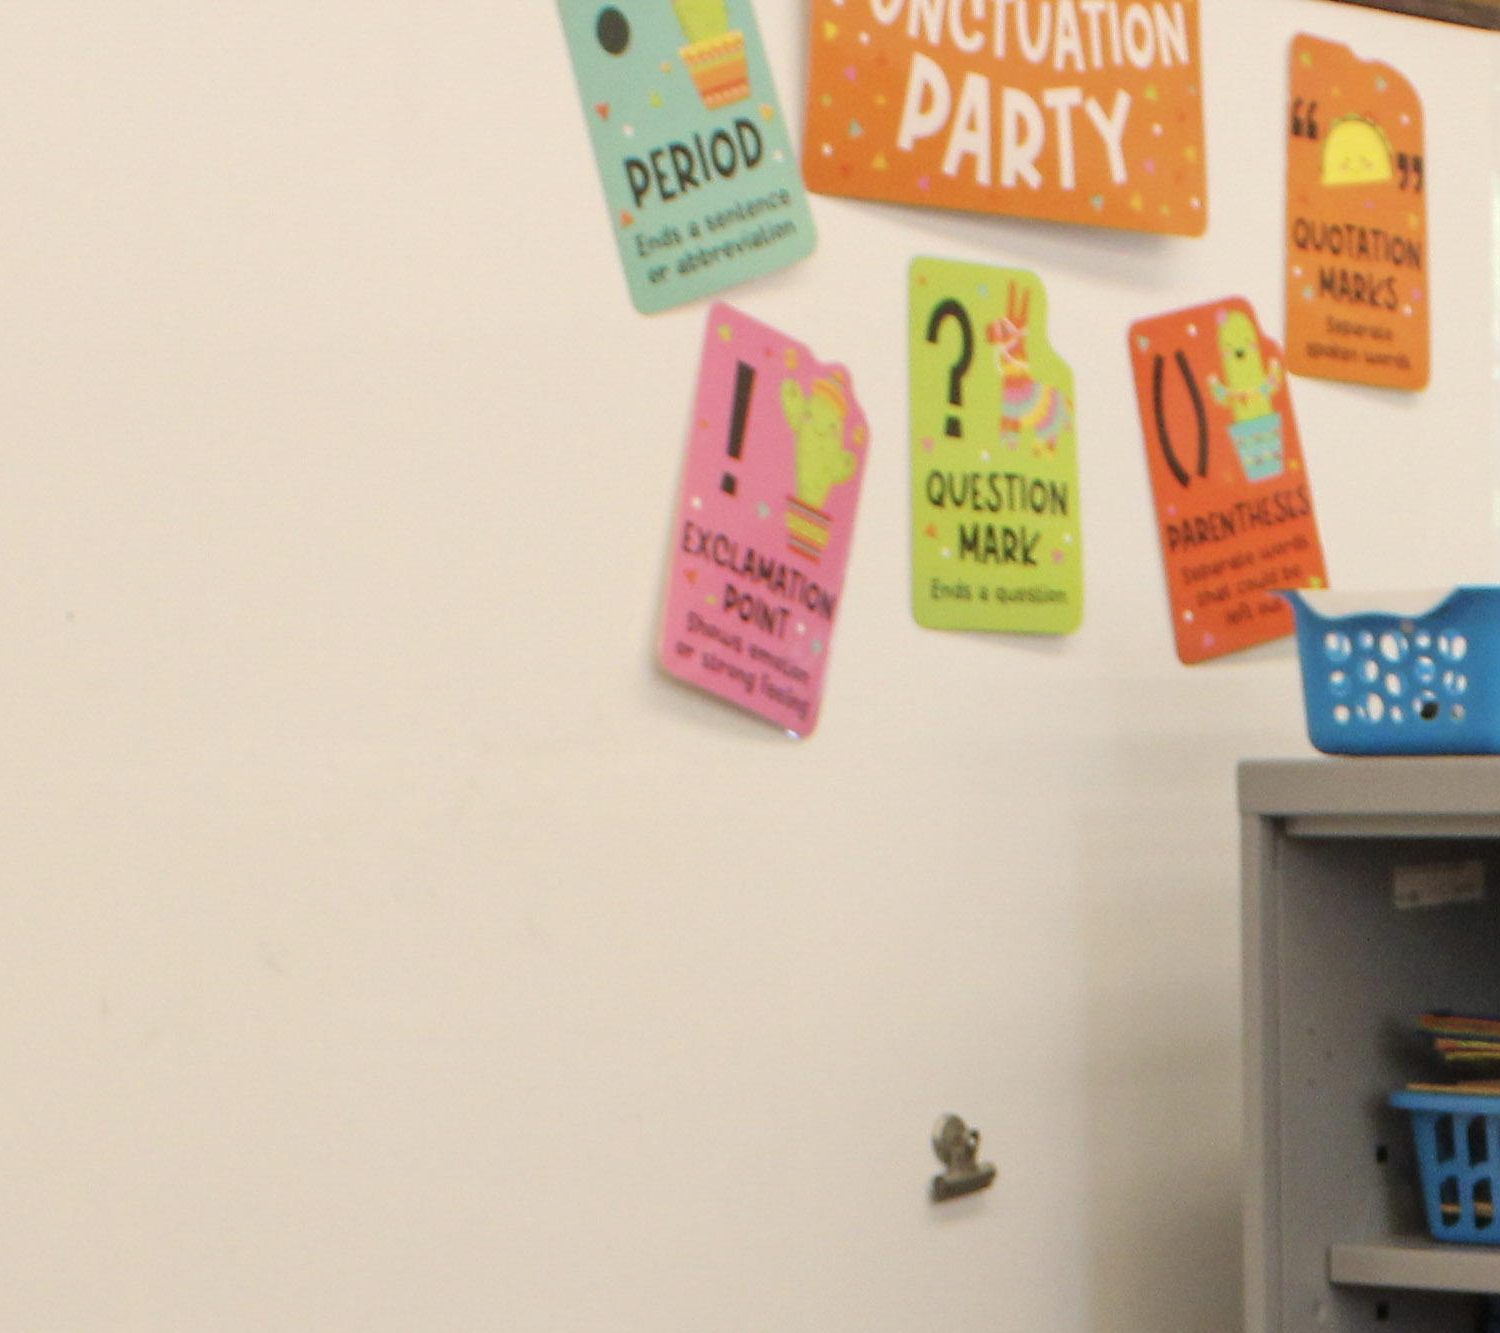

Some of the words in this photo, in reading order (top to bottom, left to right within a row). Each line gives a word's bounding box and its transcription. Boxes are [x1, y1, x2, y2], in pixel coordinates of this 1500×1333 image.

[832, 0, 1191, 72] NCTUATION
[897, 51, 1132, 191] PARTY
[622, 117, 763, 208] PERIOD
[635, 224, 683, 257] Ends
[688, 220, 701, 239] a
[705, 188, 791, 232] sentence
[647, 264, 669, 284] or
[676, 220, 797, 276] abbreviation
[1292, 216, 1422, 269] QUOTATION
[1318, 266, 1399, 311] MARKS
[926, 468, 1068, 517] QUESTION
[1166, 483, 1312, 552] PARENTHESES
[682, 520, 837, 622] EXCLAMATION
[959, 522, 1042, 567] MARK
[724, 583, 790, 639] POINT
[930, 576, 972, 600] Ends
[978, 584, 989, 601] a
[995, 586, 1069, 605] question
